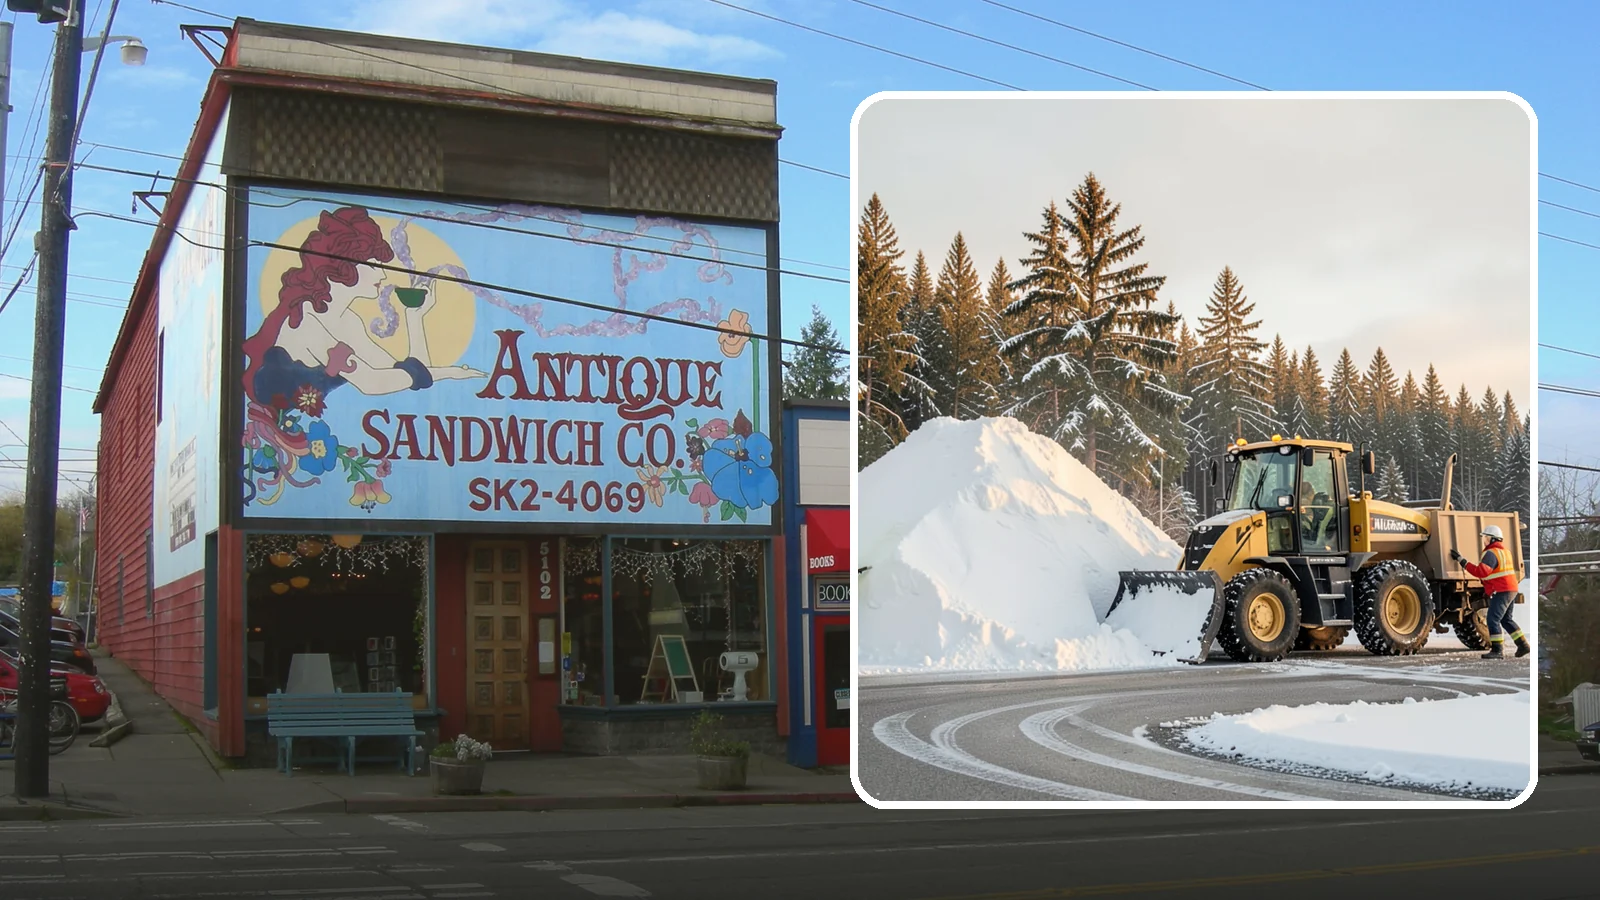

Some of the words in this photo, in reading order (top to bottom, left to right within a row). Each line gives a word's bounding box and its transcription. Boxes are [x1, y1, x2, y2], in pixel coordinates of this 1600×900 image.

[475, 328, 723, 420] ANTIQUE
[361, 409, 605, 467] SANDWICH
[617, 422, 686, 469] CO.
[468, 478, 646, 513] SK2-4069
[540, 541, 551, 600] 5102
[809, 555, 835, 569] BOOKS
